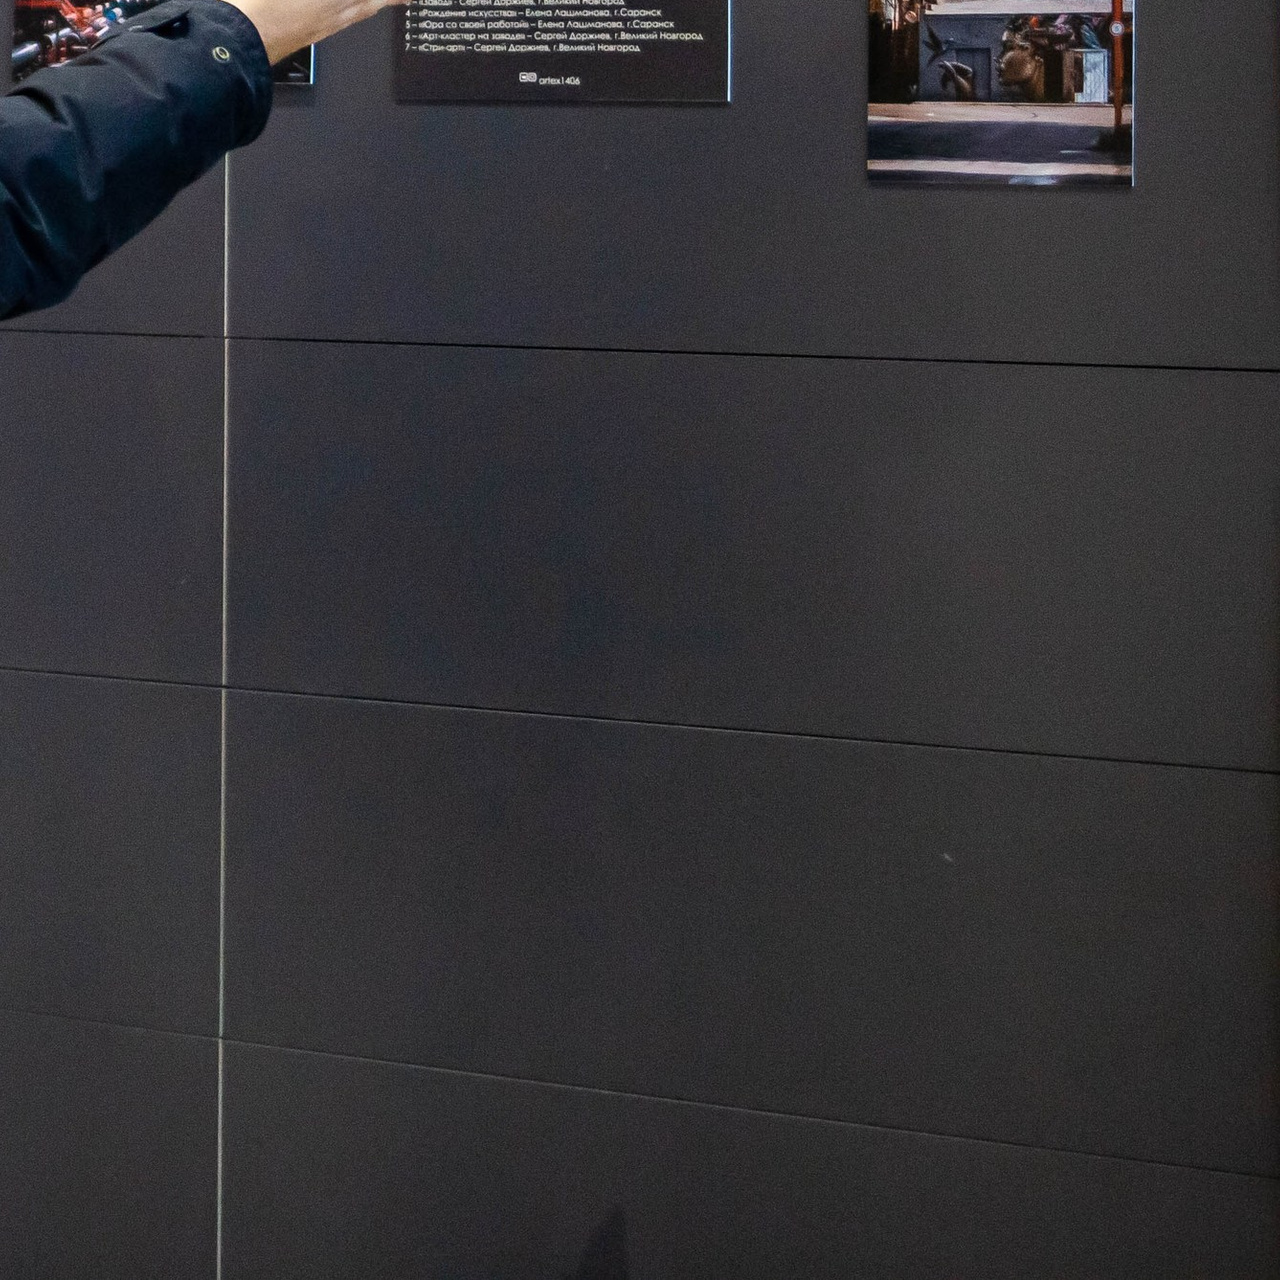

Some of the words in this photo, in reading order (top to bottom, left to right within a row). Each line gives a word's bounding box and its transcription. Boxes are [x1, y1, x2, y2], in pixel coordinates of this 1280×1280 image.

[405, 8, 410, 17] 4
[419, 8, 466, 18] «Рождение
[468, 10, 517, 18] искусства»
[525, 8, 552, 17] Елена
[554, 8, 612, 18] Лашманова,
[613, 8, 661, 18] г.Саранск
[405, 19, 410, 28] 5
[418, 19, 444, 29] «Юра
[458, 19, 486, 28] своей
[487, 19, 529, 29] работой»
[537, 19, 564, 28] Елена
[566, 19, 624, 29] Лашманова,
[626, 19, 674, 29] г.Саранск
[405, 31, 410, 40] 6
[418, 31, 476, 41] «Арт-кластер
[491, 33, 525, 41] заводе»
[533, 31, 567, 41] Сергей
[569, 31, 612, 41] Доржиев,
[614, 31, 657, 40] г.Великий
[659, 31, 703, 41] Новгород
[404, 43, 409, 51] 7
[473, 43, 506, 53] Сергей
[508, 43, 550, 53] Доржиев,
[553, 43, 595, 51] г.Великий
[597, 43, 640, 53] Новгород
